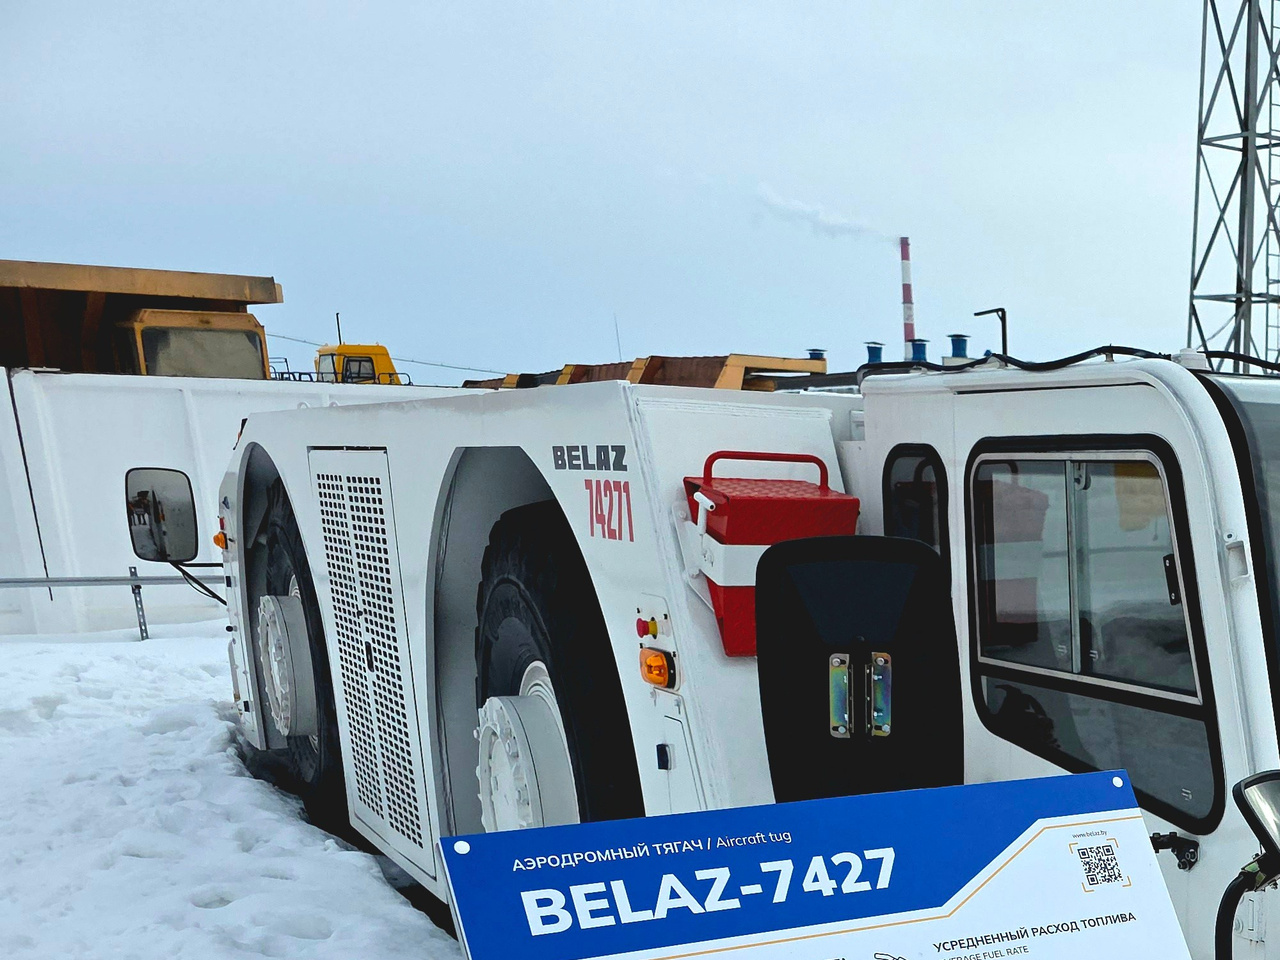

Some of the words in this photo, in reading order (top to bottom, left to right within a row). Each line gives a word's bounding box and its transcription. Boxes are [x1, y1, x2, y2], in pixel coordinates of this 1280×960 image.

[552, 445, 628, 471] BELAZ
[512, 843, 650, 871] АЭРОДРОМНЫЙ
[652, 838, 703, 856] ТЯГАЧ
[716, 831, 767, 849] Aircraft
[768, 829, 792, 844] tug
[520, 847, 896, 936] BELAZ-7427
[933, 926, 1030, 953] УСРЕДНЕННЫЙ
[1031, 920, 1079, 937] РАСХОД
[1080, 911, 1137, 928] ТОПЛИВА
[983, 948, 1006, 960] FUEL
[1006, 945, 1029, 957] RATE
